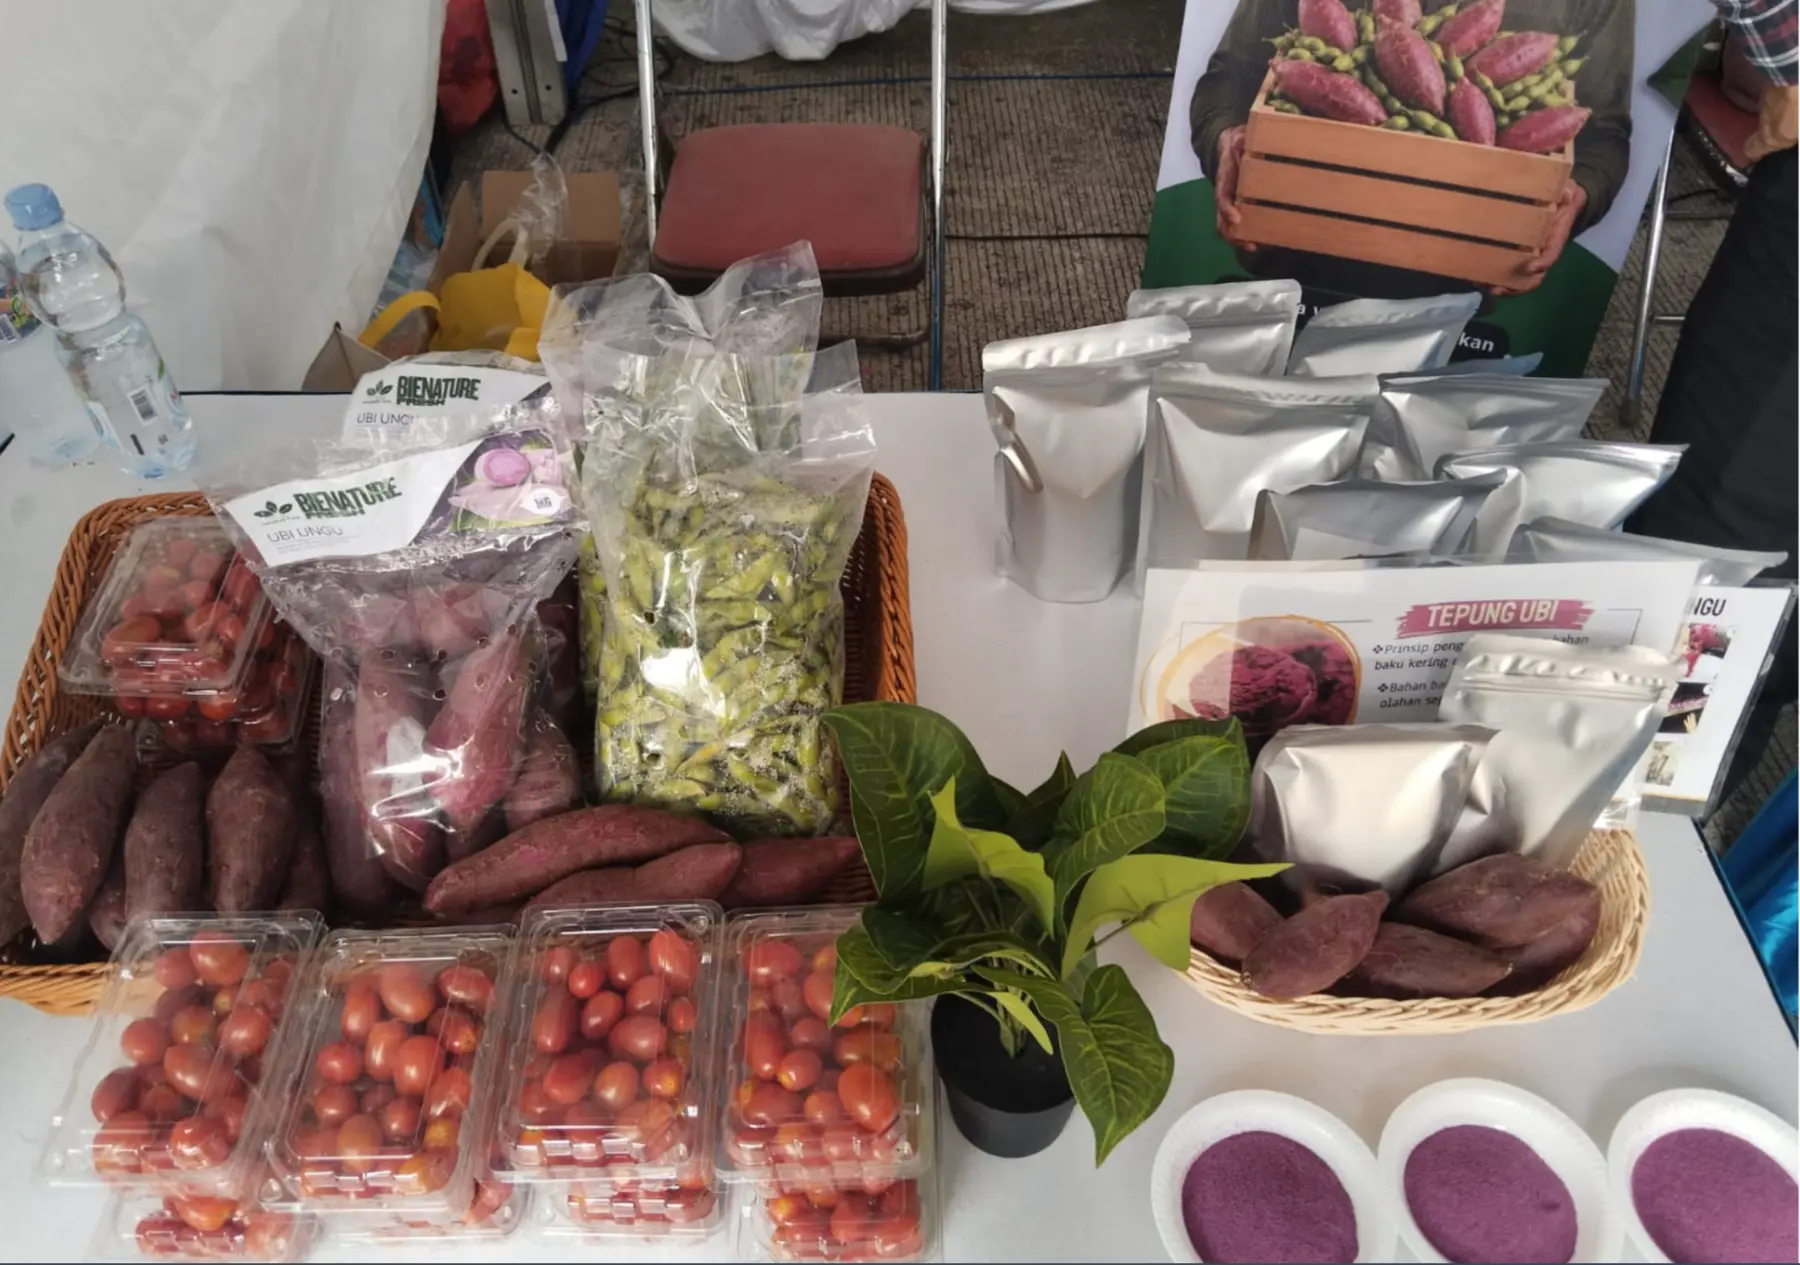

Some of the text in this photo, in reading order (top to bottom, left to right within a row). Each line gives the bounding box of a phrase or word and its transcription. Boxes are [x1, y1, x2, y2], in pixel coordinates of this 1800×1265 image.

[396, 375, 482, 401] BIENATURE
[356, 412, 420, 426] UBI UNG
[293, 476, 402, 513] BIENATURE
[266, 524, 344, 543] UBI UNGU
[1426, 600, 1559, 628] TEPUNG UBI
[1374, 658, 1404, 670] baku
[1408, 656, 1448, 669] kering
[1389, 682, 1427, 692] Bahan
[1380, 697, 1422, 708] olahan
